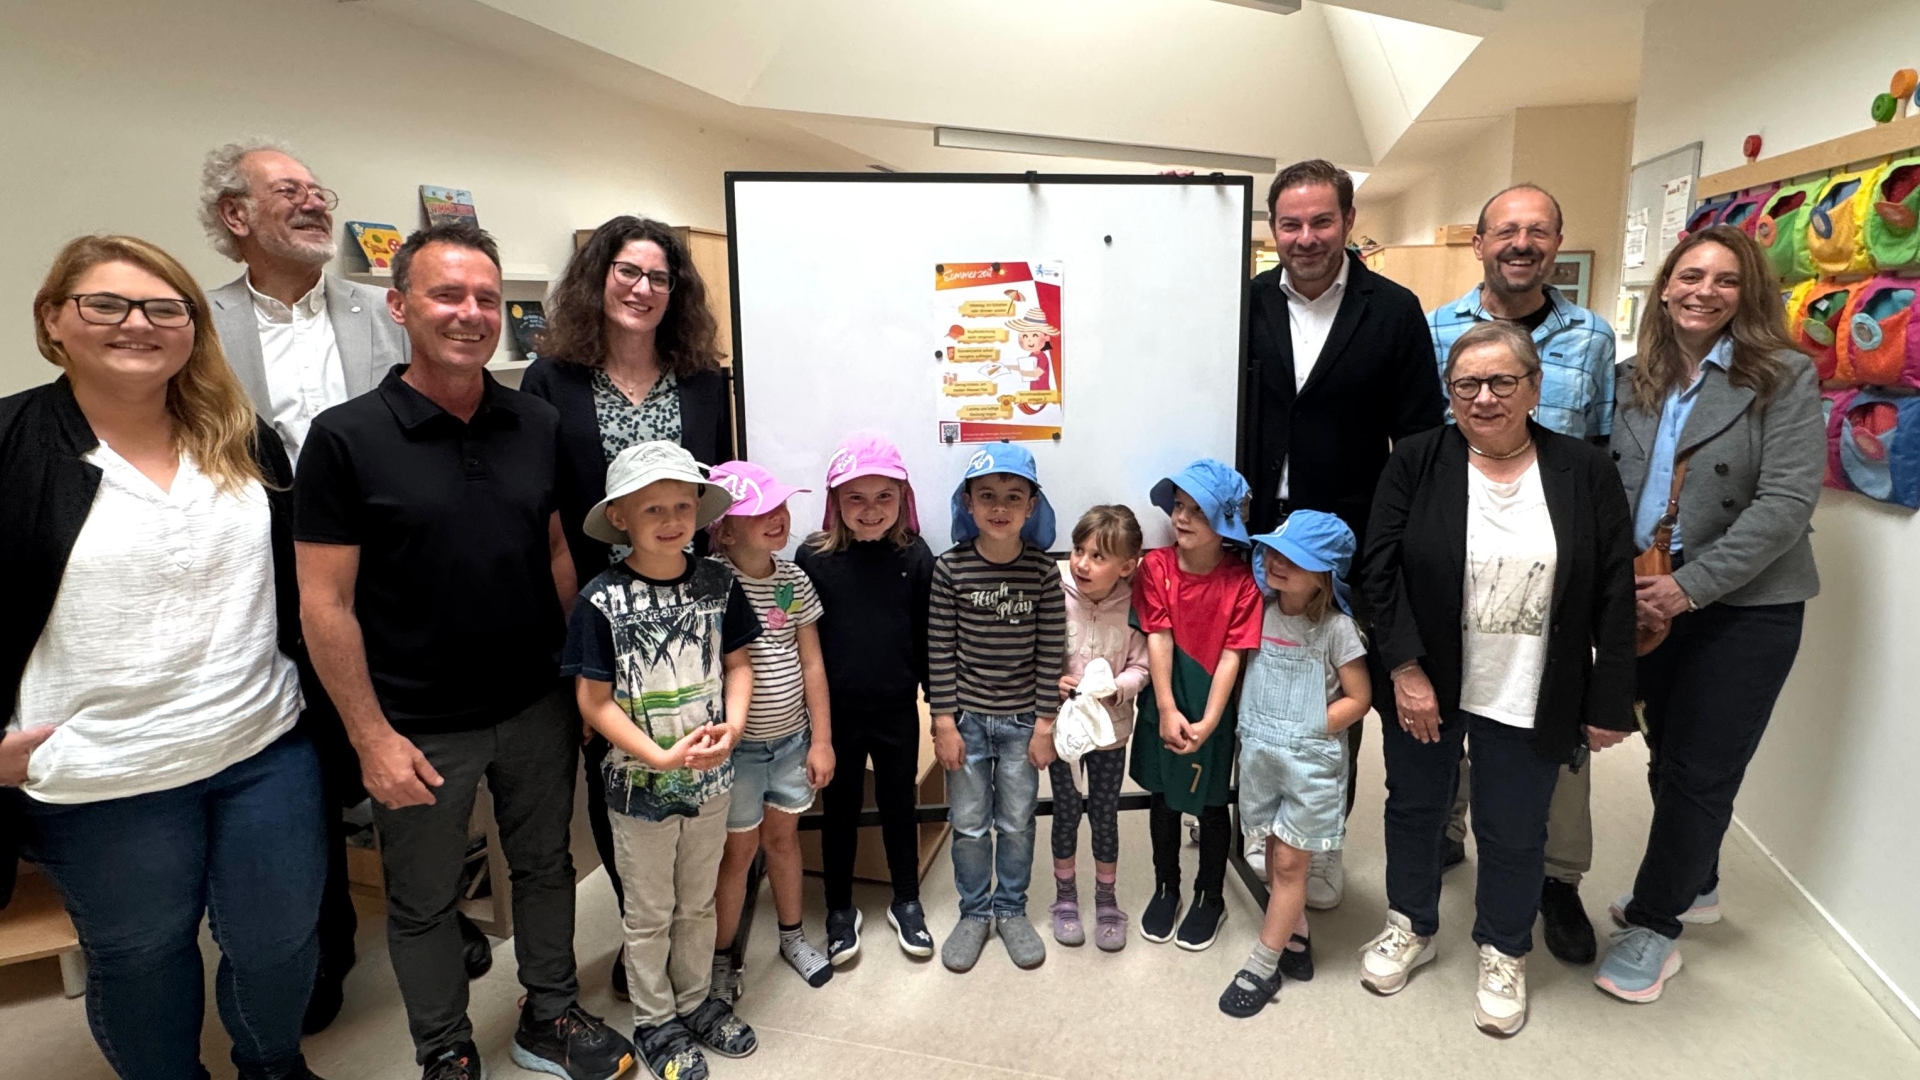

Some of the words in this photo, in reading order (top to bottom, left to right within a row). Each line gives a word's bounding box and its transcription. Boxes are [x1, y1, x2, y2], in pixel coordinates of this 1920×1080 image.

[942, 266, 993, 282] Sommerzeit
[970, 581, 1008, 607] High
[995, 599, 1034, 621] Play
[1190, 763, 1202, 793] 7
